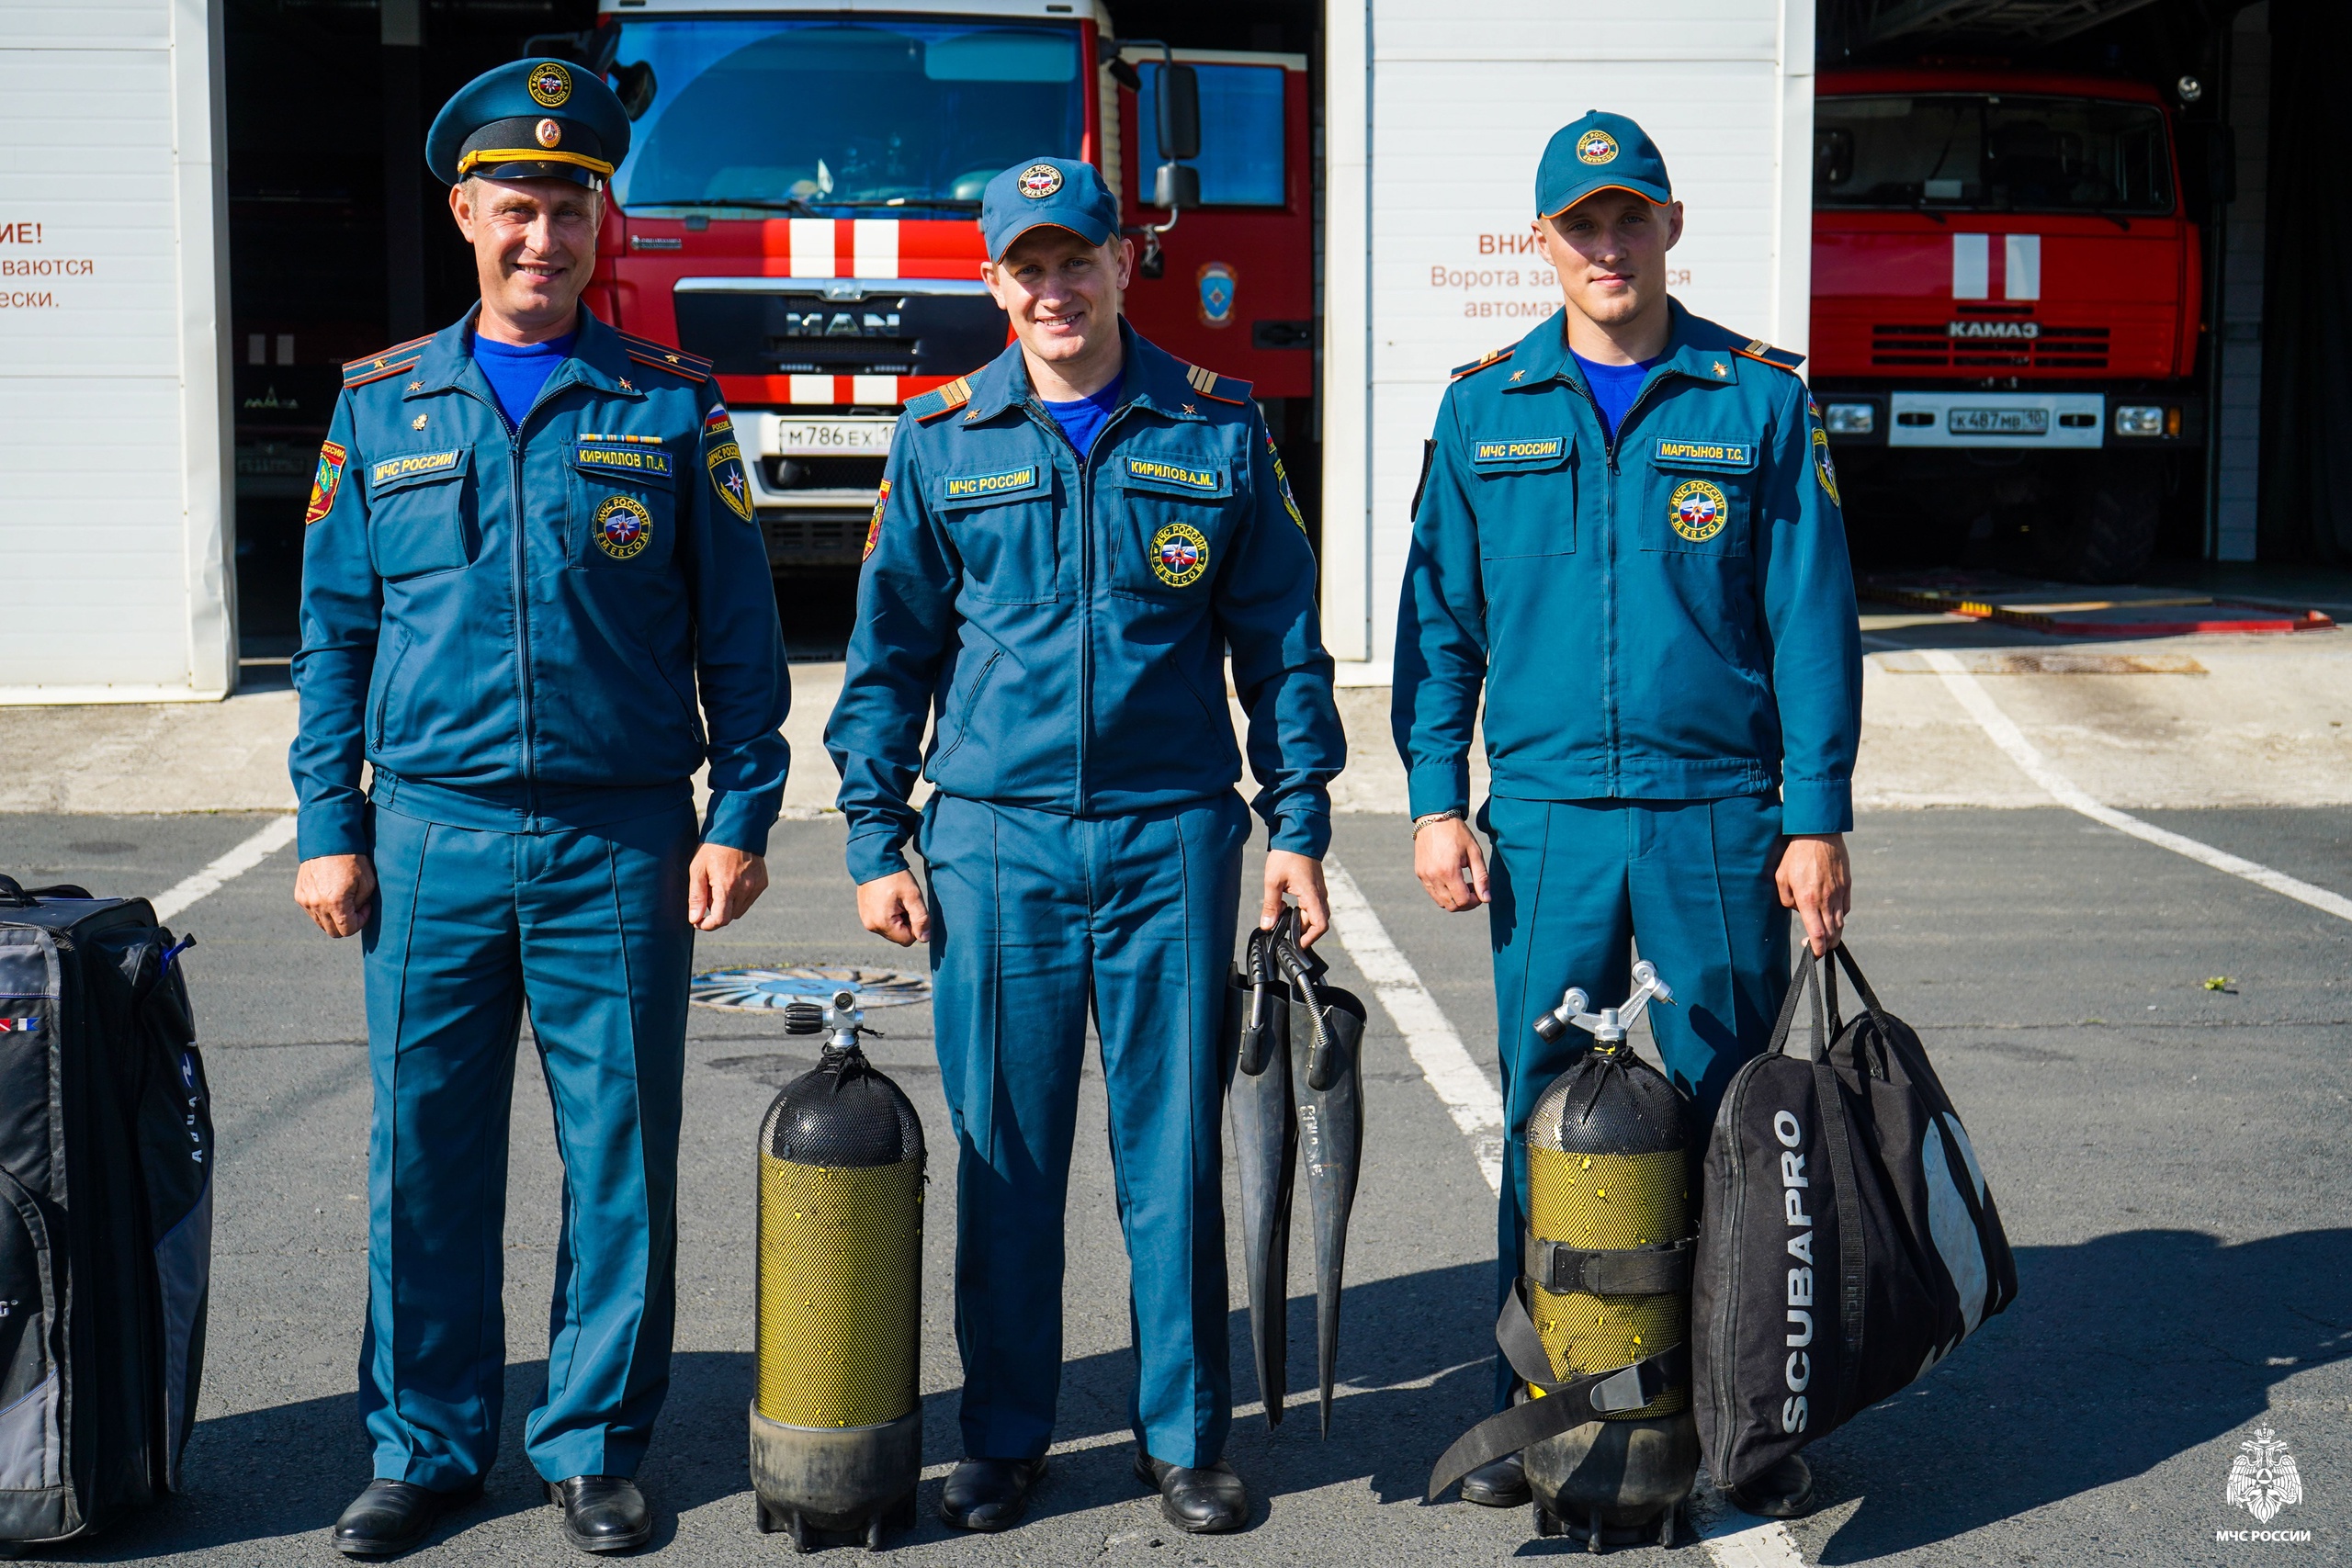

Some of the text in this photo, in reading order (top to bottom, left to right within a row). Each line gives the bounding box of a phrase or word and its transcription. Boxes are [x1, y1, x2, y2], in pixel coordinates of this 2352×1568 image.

[532, 66, 569, 85] МЧС РОССИИ
[533, 88, 567, 104] EMERCOM
[2, 259, 93, 276] ваются
[1430, 265, 1521, 290] Ворота
[786, 312, 900, 337] MAN
[1949, 321, 2040, 339] КАМАЗ
[579, 449, 668, 472] КИРИЛЛОВ П.А.
[708, 449, 723, 466] МЧС
[1479, 441, 1557, 457] МЧС РОССИИ
[1661, 443, 1744, 461] МАРТЫНОВ Т.С.
[375, 452, 454, 481] МЧС РОССИИ
[949, 469, 1030, 495] МЧС РОССИИ
[1672, 482, 1724, 510] МЧС РОССИИ
[597, 498, 649, 525] МЧС РОССИИ
[1672, 512, 1724, 538] EMERCOM
[597, 532, 648, 557] EMERCOM
[1155, 525, 1206, 551] МЧС РОССИИ
[1153, 556, 1204, 584] EMERCOM
[1773, 1110, 1814, 1434] SCUBAPRO
